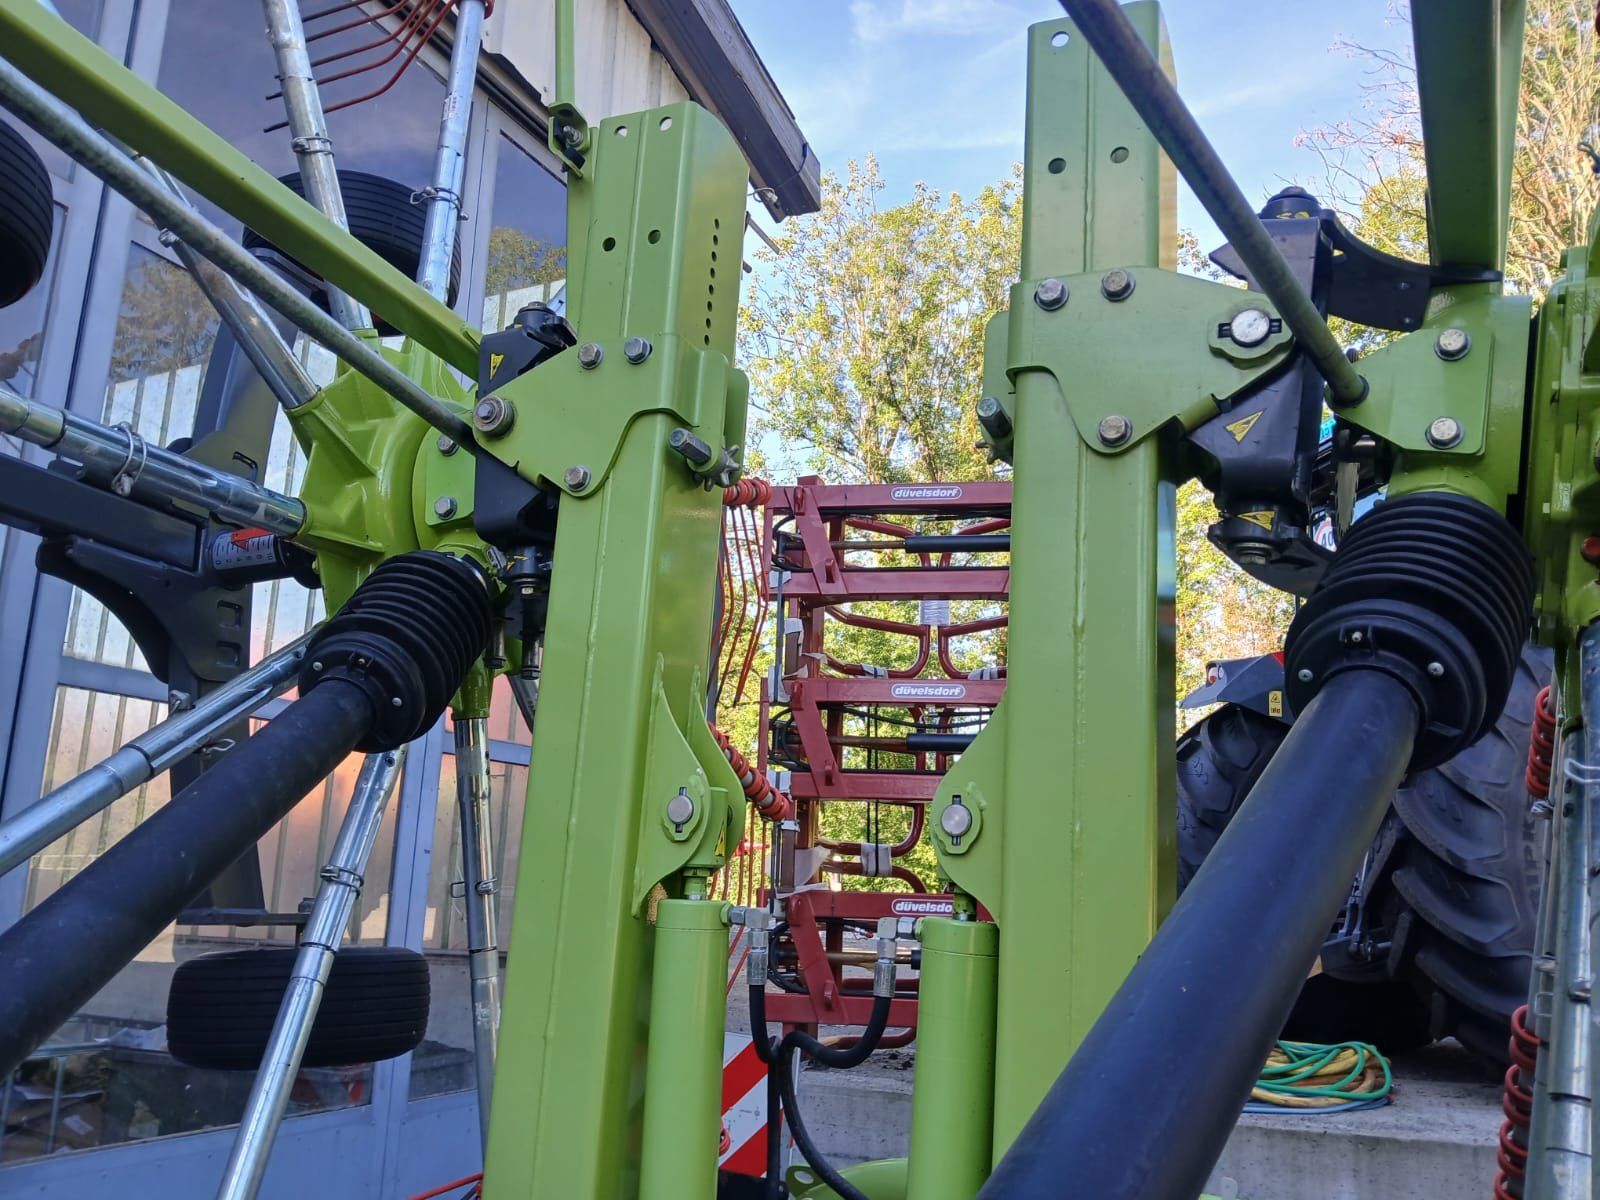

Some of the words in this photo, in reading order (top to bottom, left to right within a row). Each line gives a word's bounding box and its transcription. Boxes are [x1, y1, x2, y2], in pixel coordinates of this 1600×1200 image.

[894, 488, 959, 498] düvelsdorf
[894, 686, 961, 696] düvelsdorf
[894, 901, 954, 913] düvelsdo
